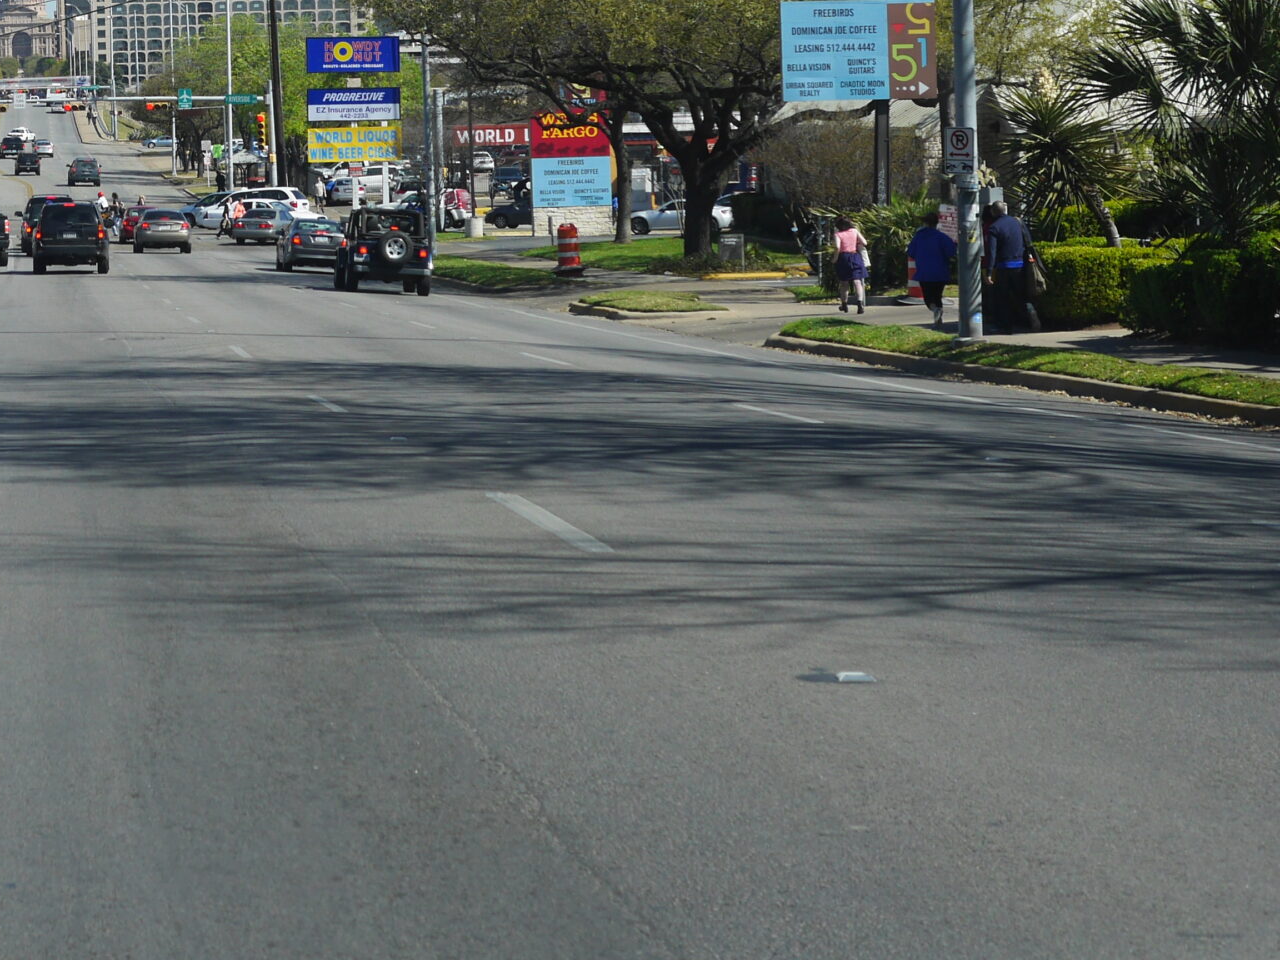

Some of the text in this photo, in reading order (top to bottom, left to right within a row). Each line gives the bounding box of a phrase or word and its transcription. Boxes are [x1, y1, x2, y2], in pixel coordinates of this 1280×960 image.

[813, 8, 854, 17] FREEBIRDS
[791, 25, 877, 36] DOMINICAN JOE COFFEE
[794, 43, 876, 53] LEASING 512.444.4442
[847, 58, 877, 66] QUINCY'S
[787, 63, 831, 72] BELLA VISION
[848, 67, 875, 75] GUITARS
[807, 81, 833, 89] SQUARED
[799, 89, 820, 97] REALTY
[850, 88, 876, 96] STUDIOS
[323, 92, 385, 102] PROGRESSIVE
[327, 105, 363, 113] Insurance
[365, 105, 392, 114] Agency
[315, 131, 353, 144] WORLD
[457, 128, 515, 144] WORLD
